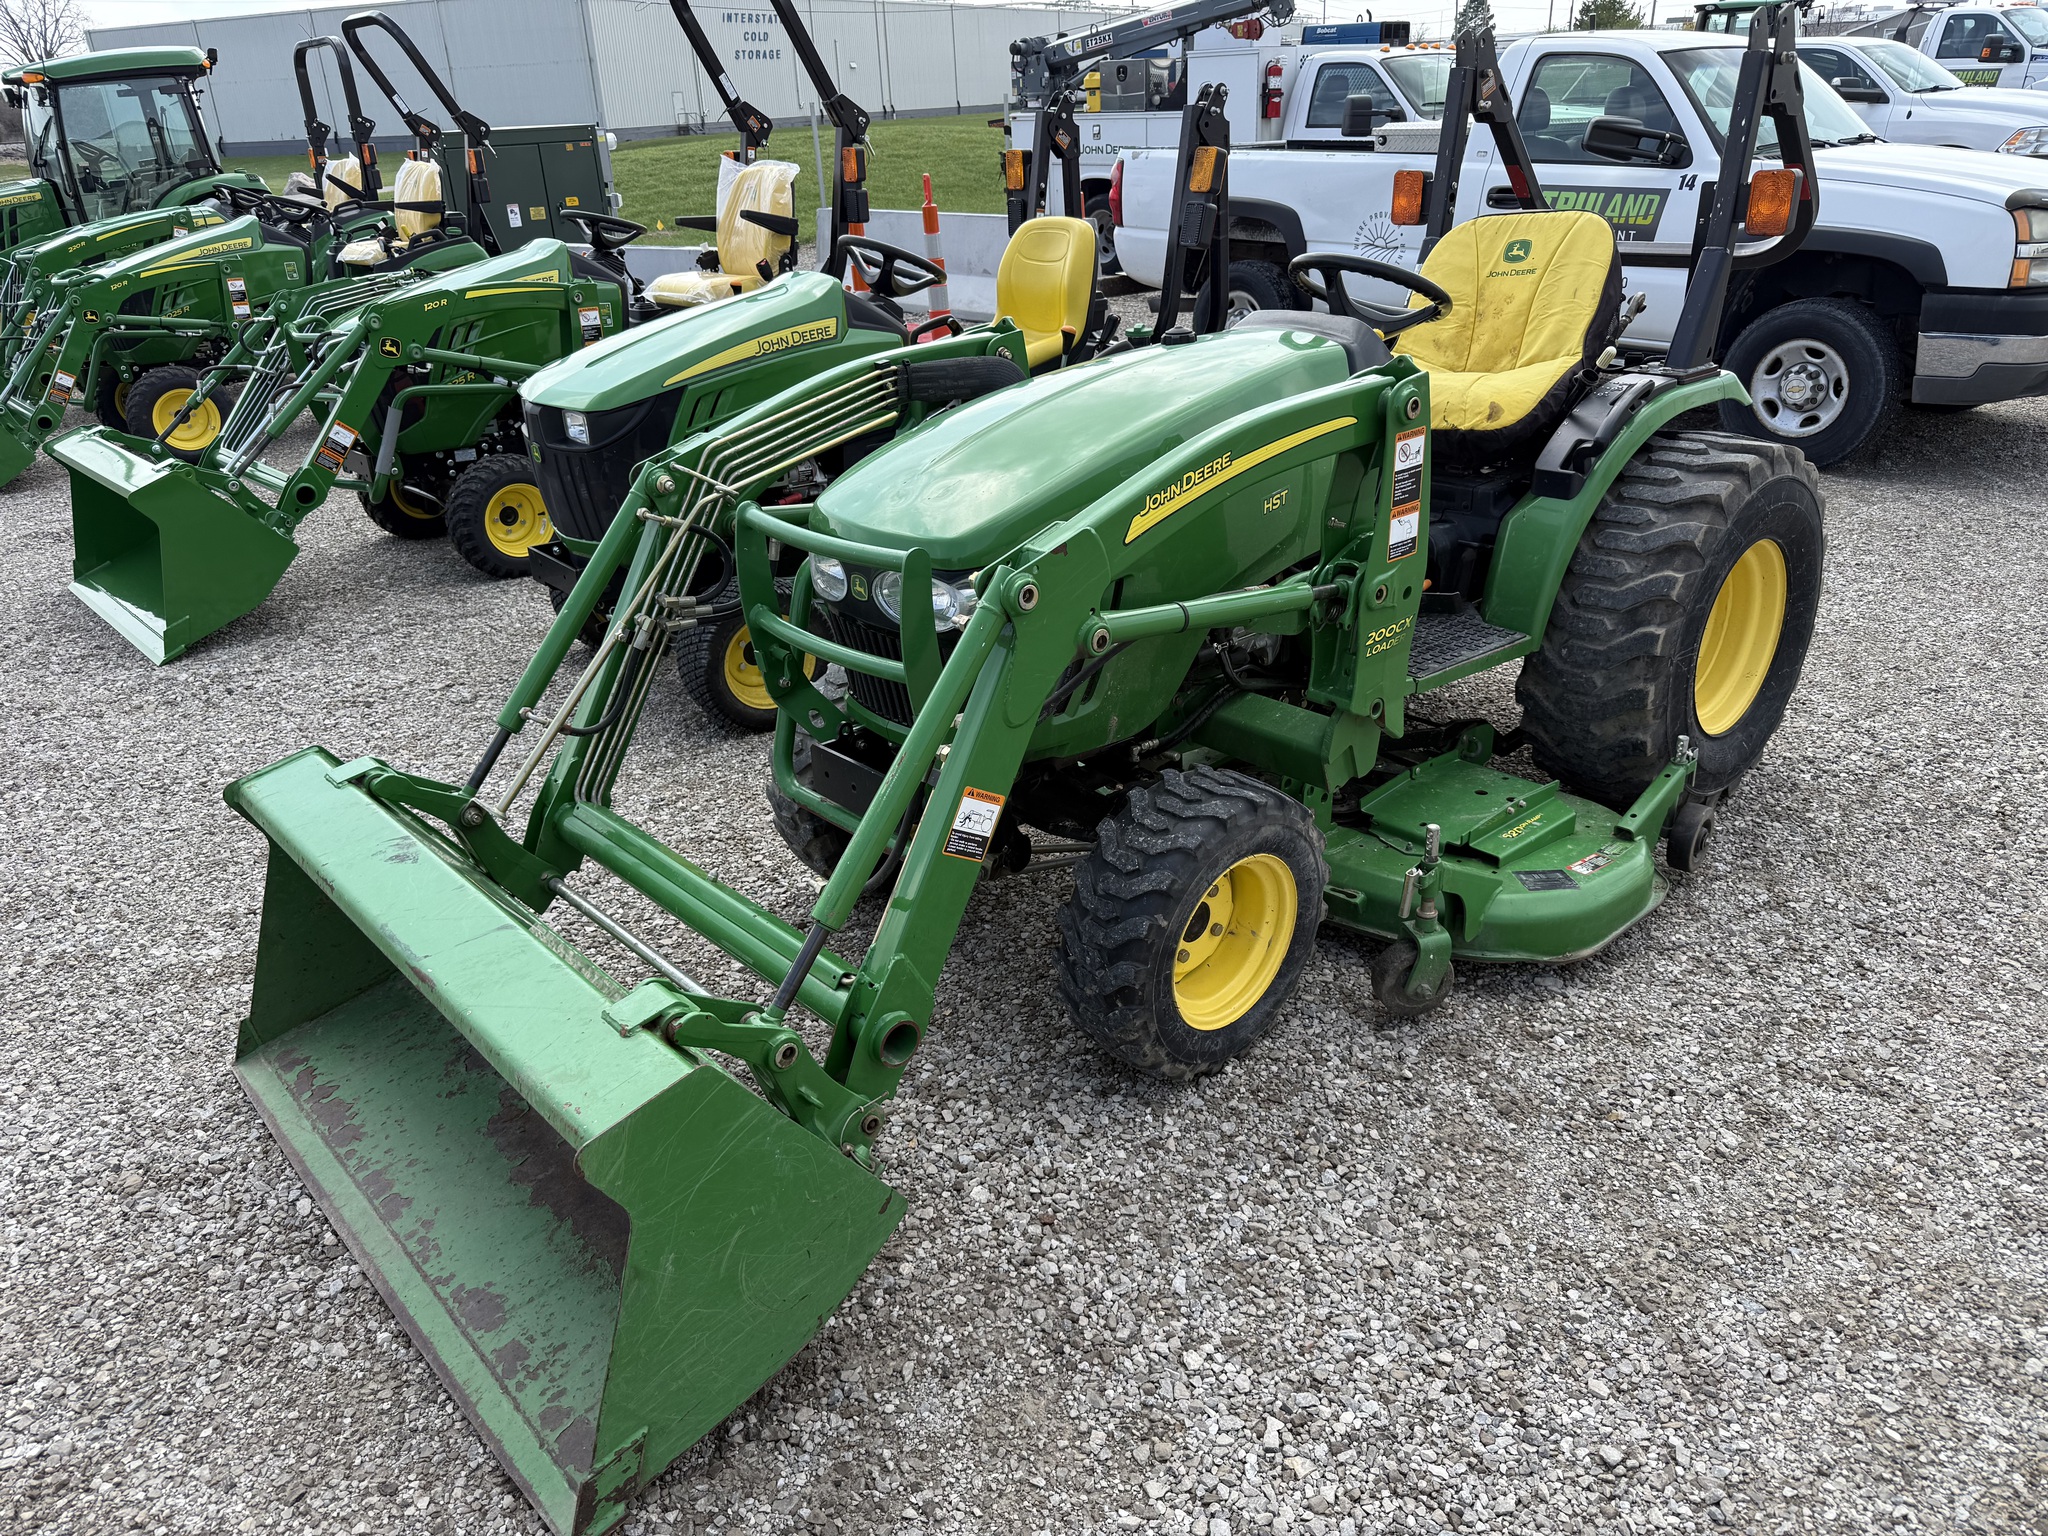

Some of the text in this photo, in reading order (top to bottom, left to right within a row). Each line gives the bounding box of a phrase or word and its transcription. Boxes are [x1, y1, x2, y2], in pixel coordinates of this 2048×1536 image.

[722, 12, 782, 24] INTERSTAT
[743, 31, 769, 41] COLD
[1086, 34, 1112, 48] ET25KX
[734, 49, 781, 60] STORAGE
[1080, 144, 1103, 154] JOHN
[1678, 174, 1698, 191] 14
[13, 195, 37, 203] DEERE
[199, 241, 249, 256] JOHN DEERE
[1486, 268, 1537, 278] JOHN DEERE
[162, 308, 183, 318] 025
[424, 302, 440, 312] 120
[754, 326, 832, 355] JOHN DEERE
[1401, 427, 1425, 439] WARNING
[1140, 451, 1233, 517] JOHN DEERE
[1264, 490, 1288, 514] HST
[1365, 614, 1414, 646] 200CX
[1366, 633, 1406, 657] LOADER
[975, 791, 1001, 803] WARNING
